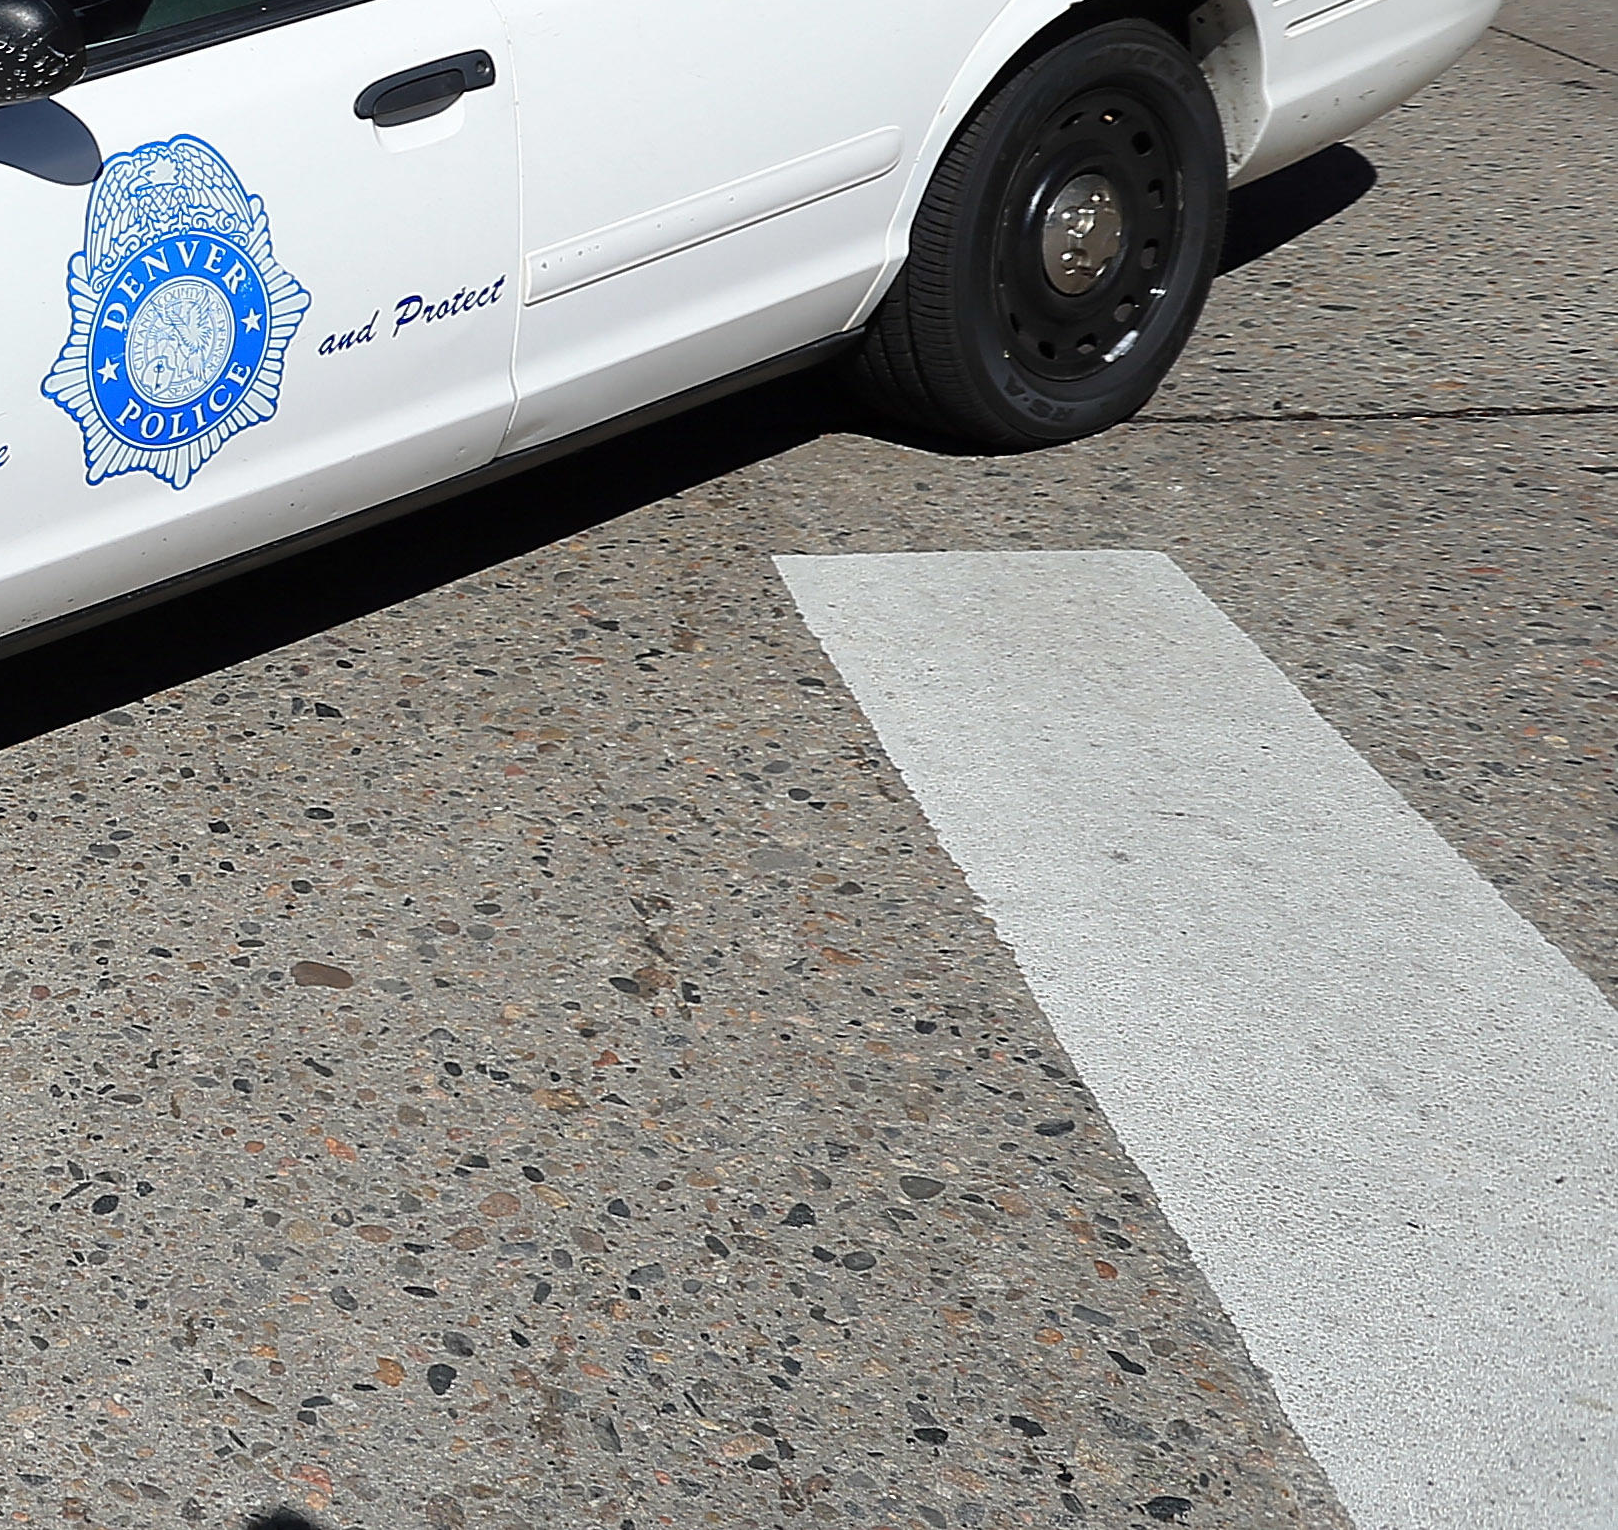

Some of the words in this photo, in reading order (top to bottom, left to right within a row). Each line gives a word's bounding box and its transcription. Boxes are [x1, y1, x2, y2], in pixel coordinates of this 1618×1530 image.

[102, 239, 252, 334] DENVER
[318, 309, 380, 356] and
[392, 274, 506, 337] Protect
[115, 362, 252, 440] POLICE
[167, 382, 196, 398] SEAL
